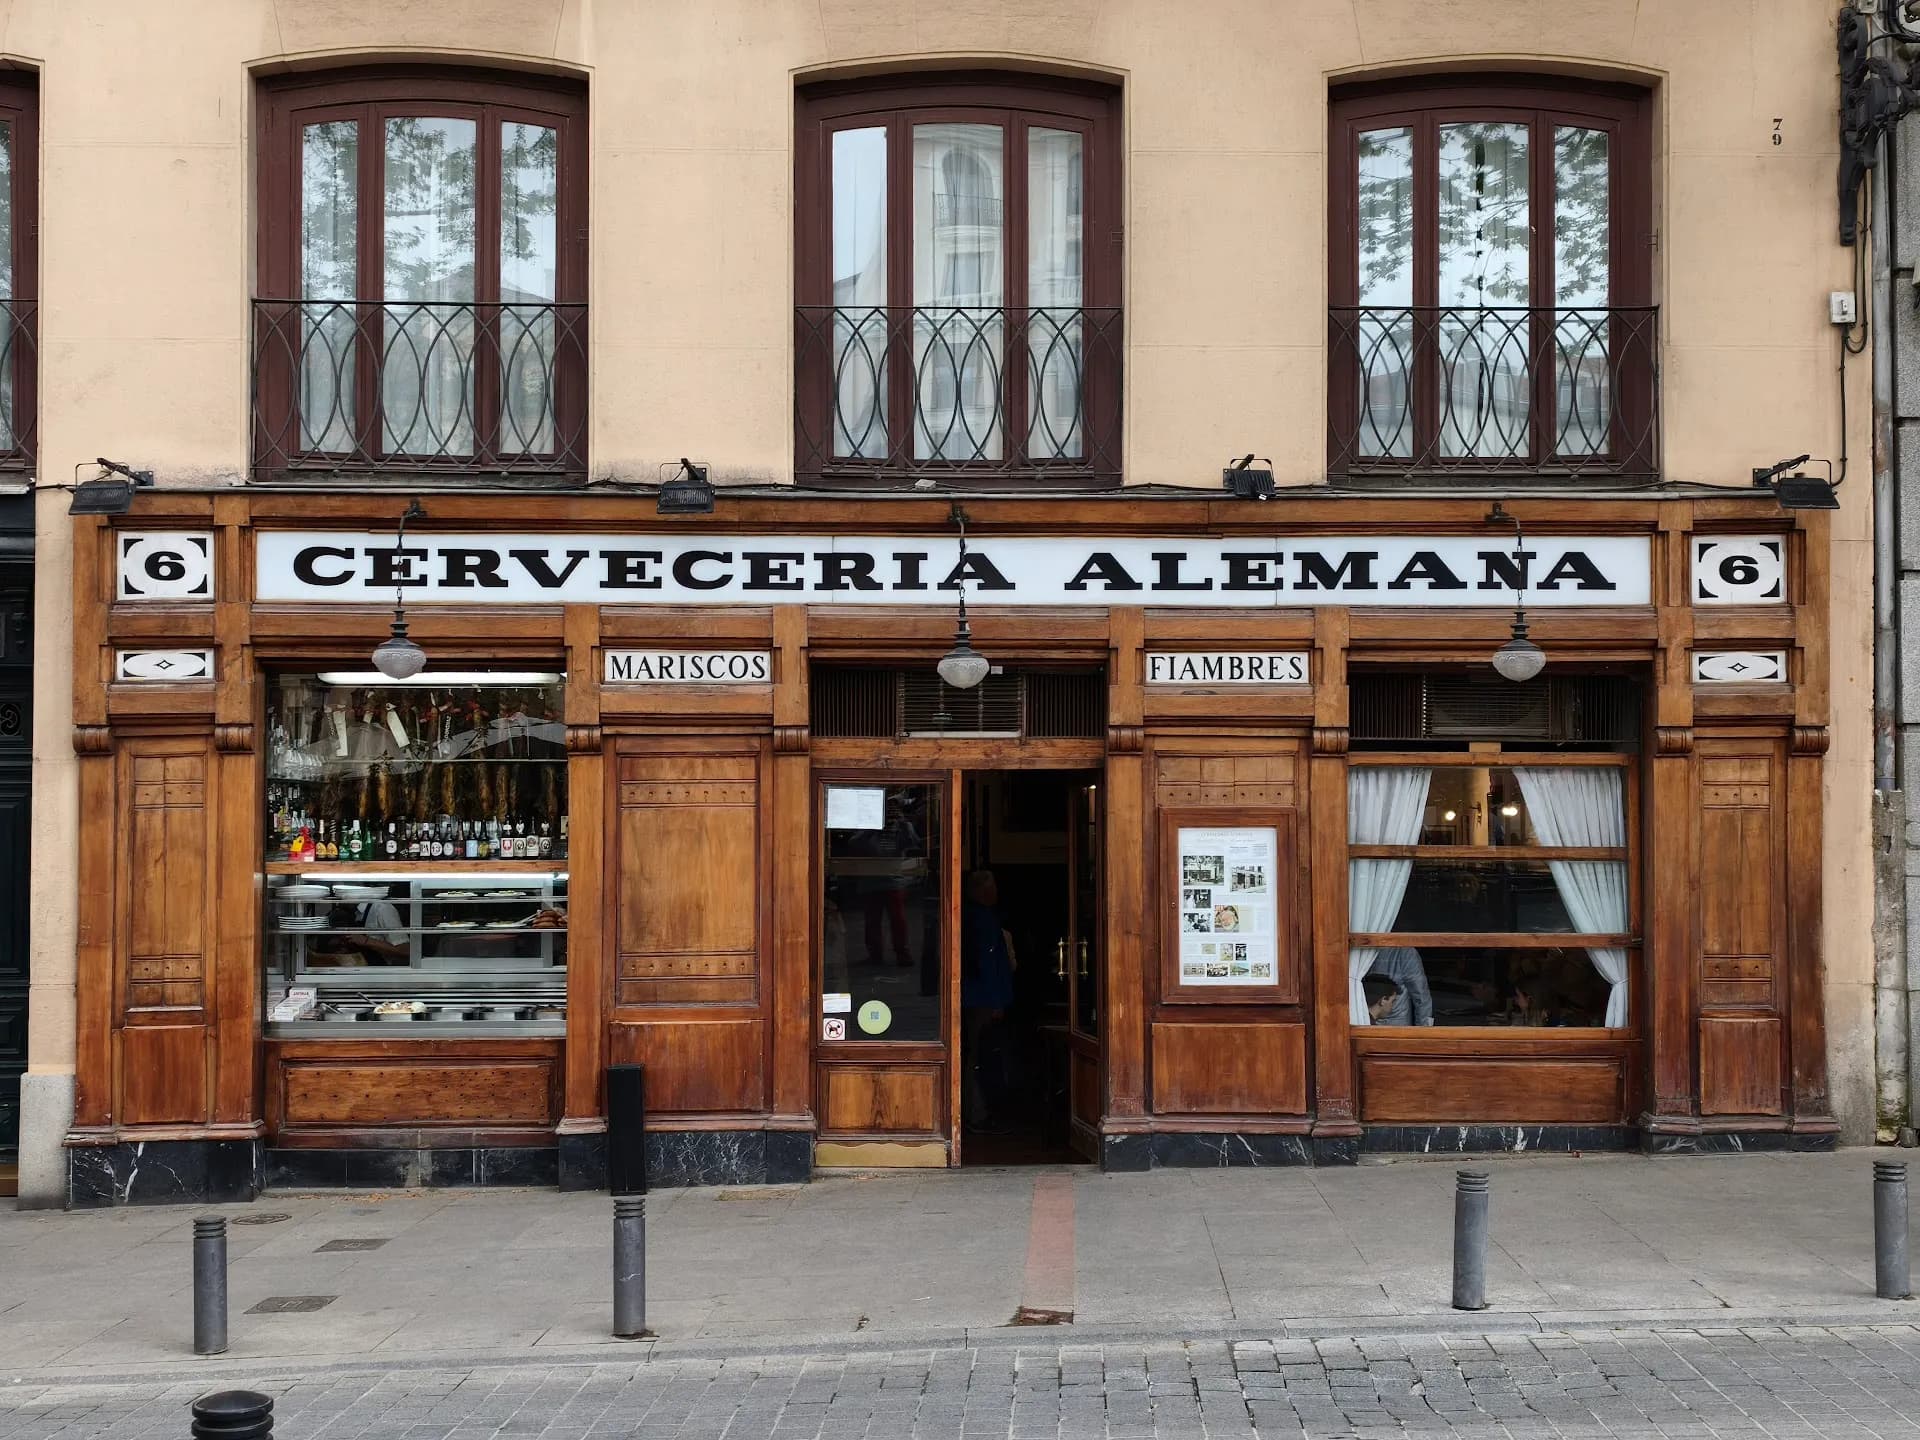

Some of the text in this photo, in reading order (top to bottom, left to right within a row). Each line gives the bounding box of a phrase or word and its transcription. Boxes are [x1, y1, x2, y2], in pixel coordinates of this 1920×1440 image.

[144, 551, 186, 581] 6
[293, 546, 1617, 591] CERVECERIA ALEMANA
[1719, 555, 1759, 585] 6
[610, 652, 767, 682] MARISCOS
[1149, 654, 1304, 682] FIAMBRES
